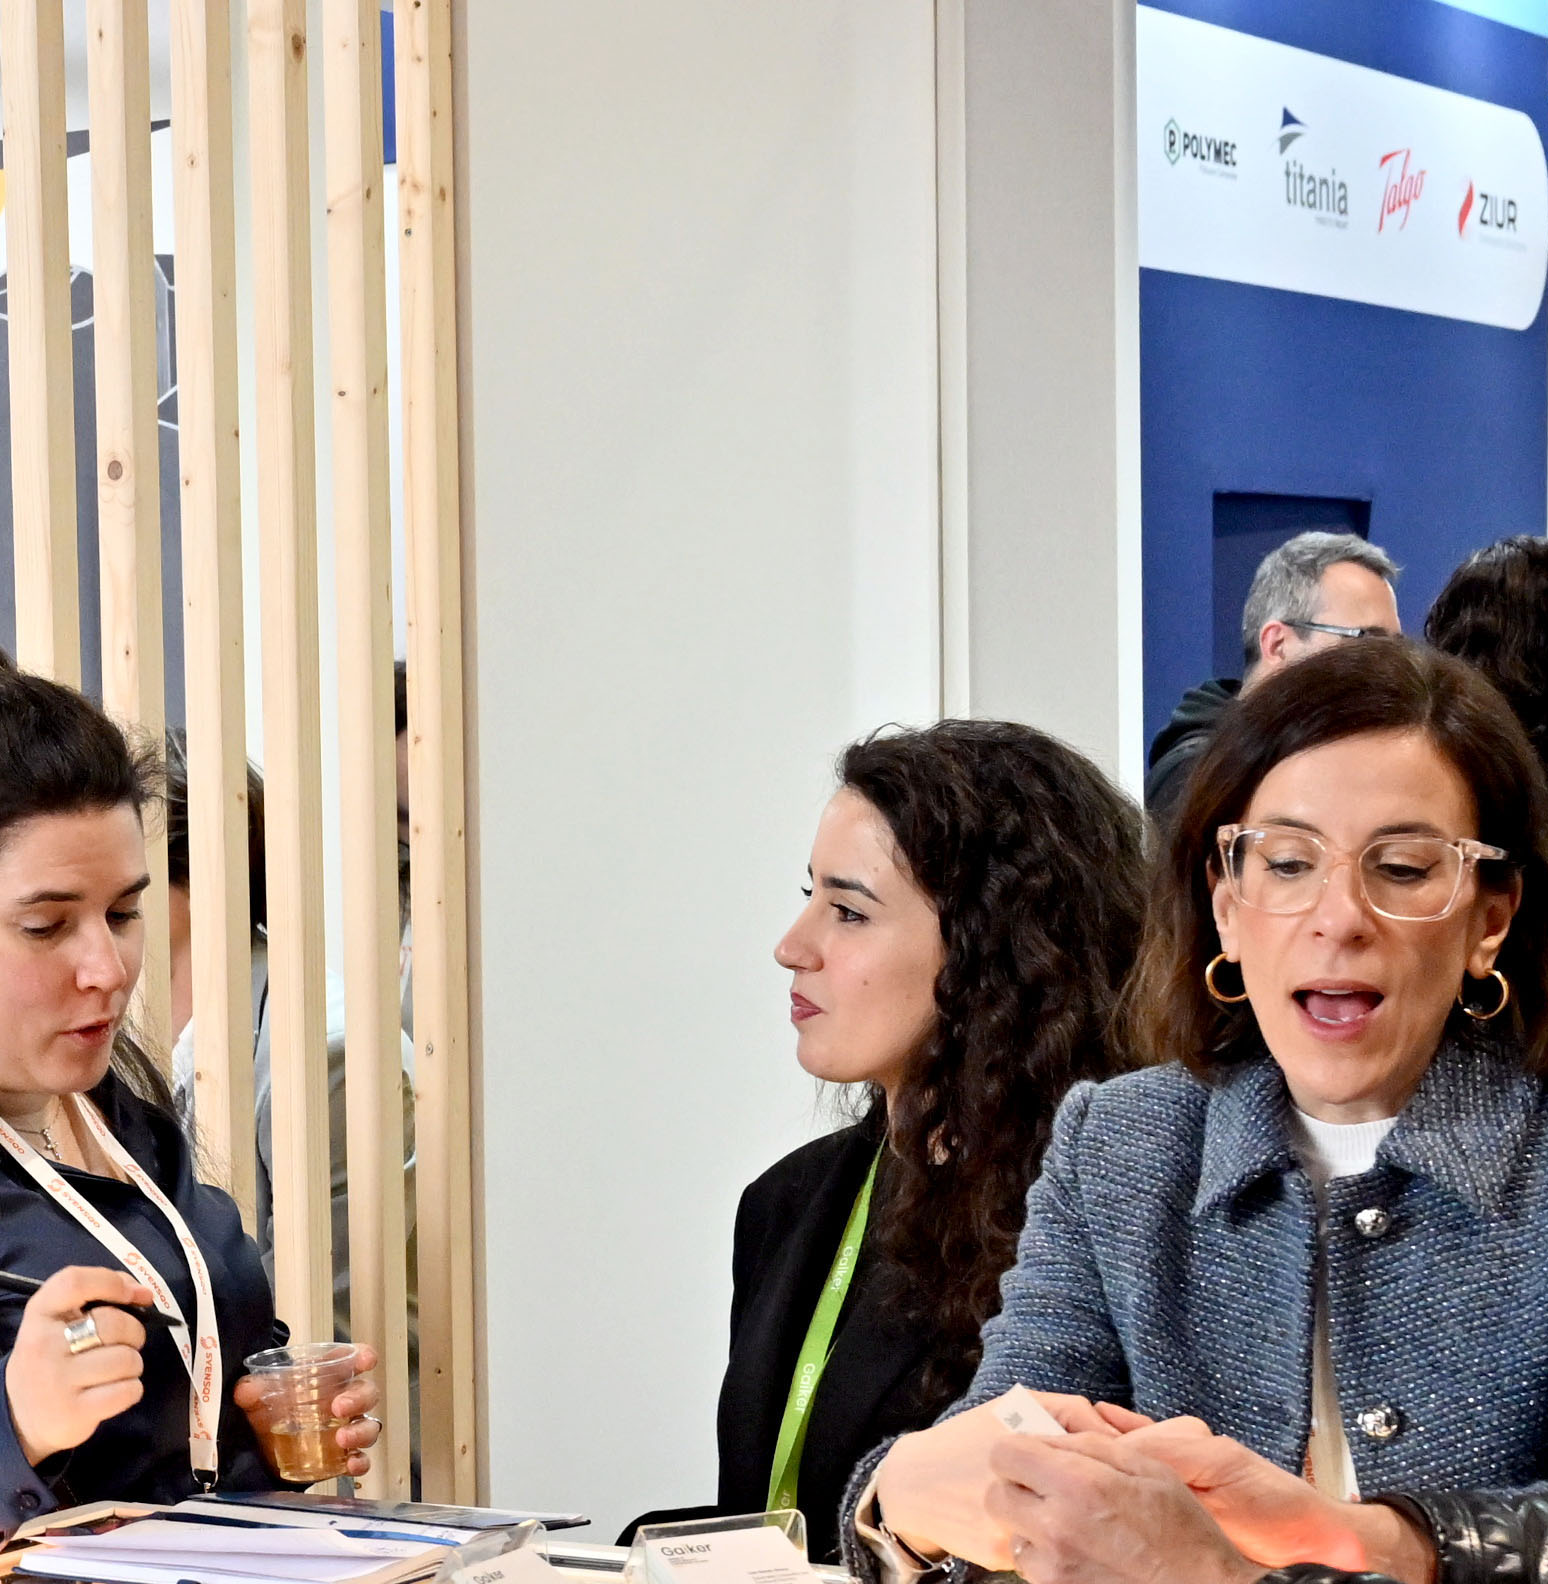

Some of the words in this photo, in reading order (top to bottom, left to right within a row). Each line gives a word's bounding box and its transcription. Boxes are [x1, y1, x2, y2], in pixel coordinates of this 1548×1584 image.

[1183, 132, 1238, 168] POLYMEC
[1284, 160, 1349, 216] titania
[1480, 194, 1518, 232] ZIUR
